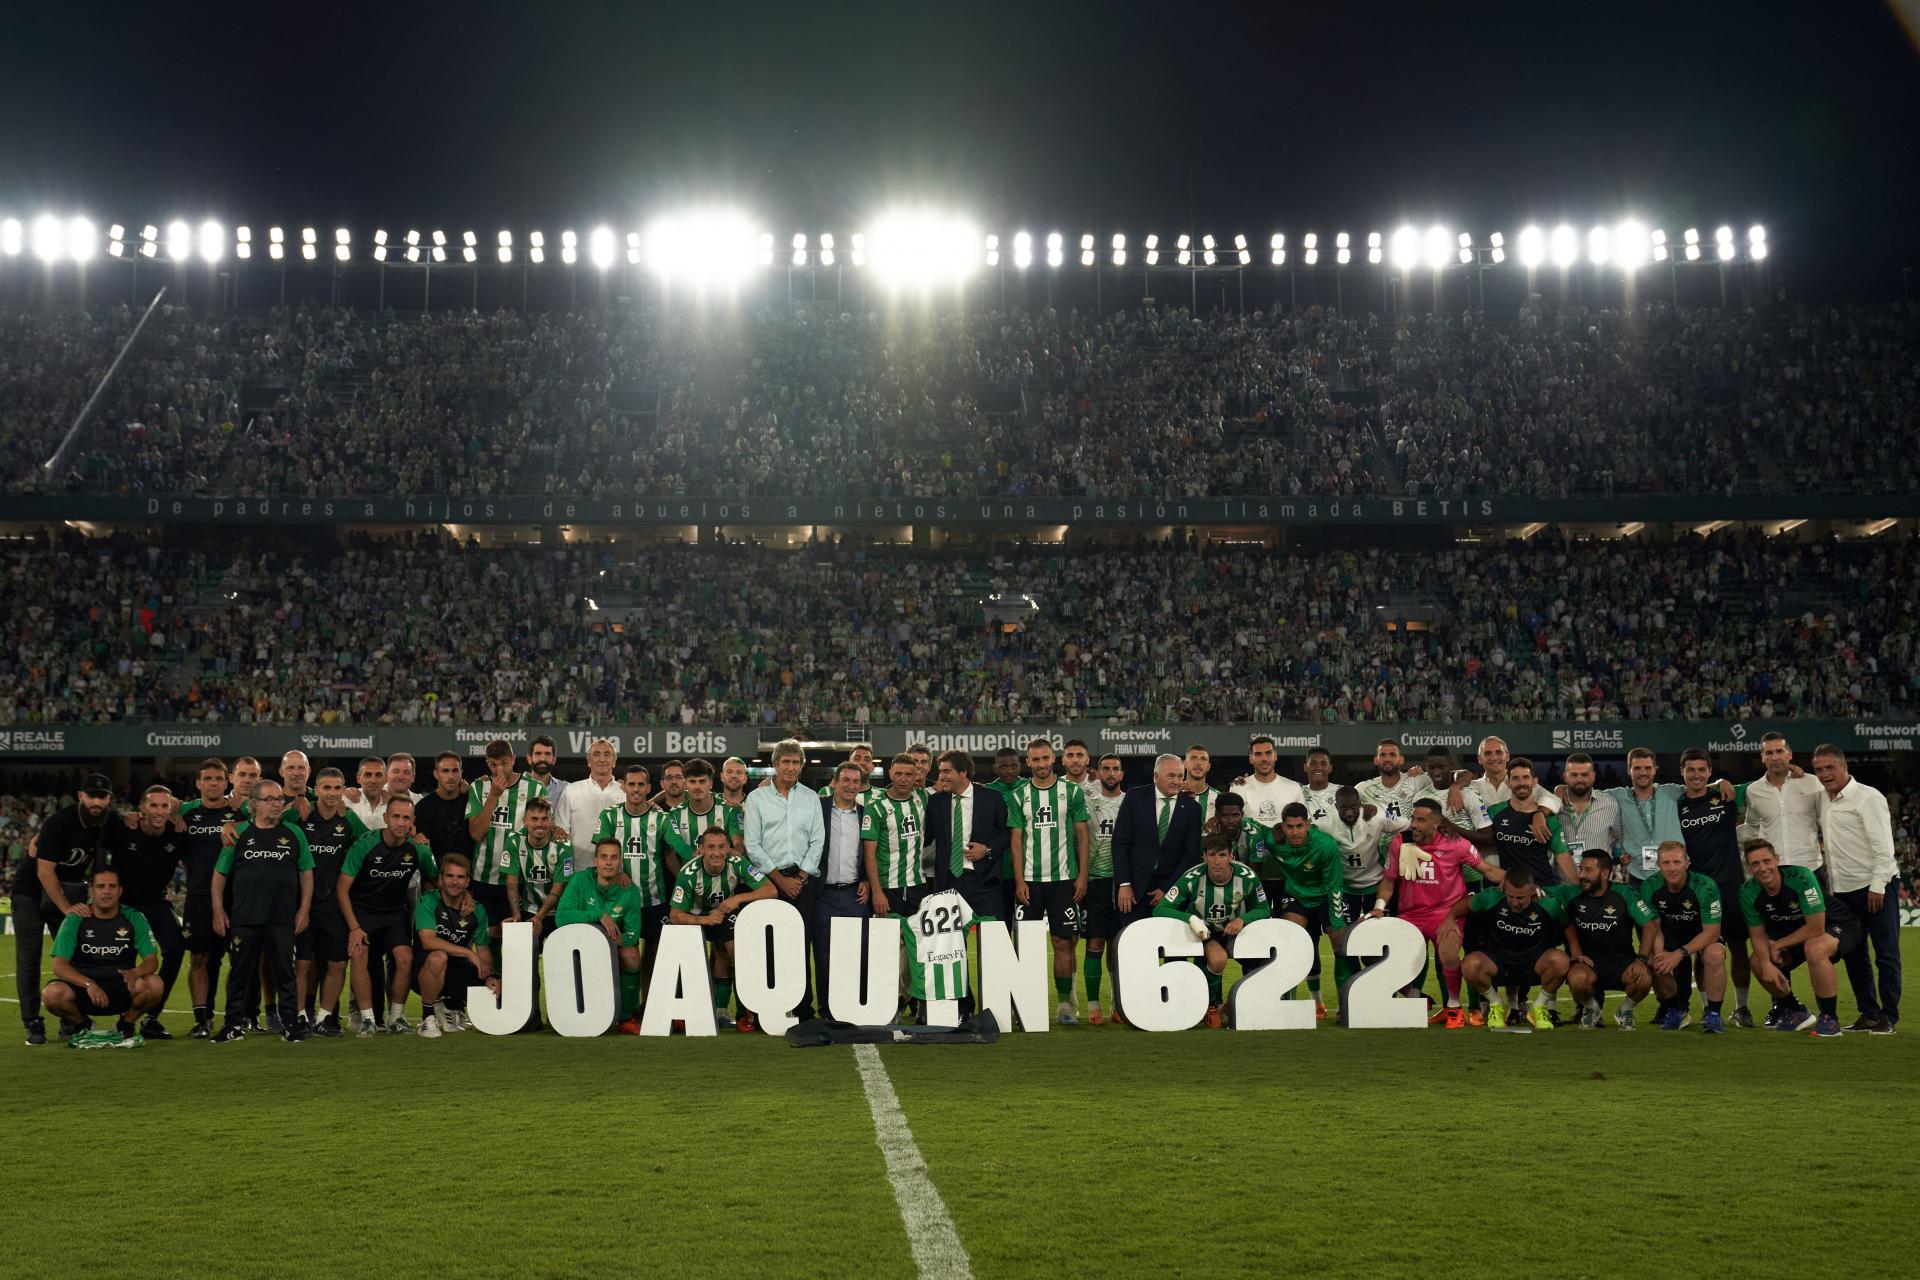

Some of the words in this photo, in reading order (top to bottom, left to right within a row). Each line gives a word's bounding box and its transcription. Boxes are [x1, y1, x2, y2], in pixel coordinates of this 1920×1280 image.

[148, 498, 182, 515] De
[214, 499, 334, 518] padres
[364, 504, 374, 516] a
[543, 501, 576, 518] de
[613, 501, 750, 518] abuelos
[788, 506, 797, 518] a
[981, 505, 1035, 518] una
[1073, 501, 1188, 520] pasión
[1224, 501, 1362, 517] llamada
[1392, 500, 1493, 516] BETIS
[13, 732, 65, 742] REALE
[147, 732, 221, 747] Cruzcampo
[455, 728, 527, 741] finetwork
[1100, 727, 1171, 740] finetwork
[1574, 730, 1623, 740] REALE
[319, 735, 374, 749] hummel
[568, 731, 620, 753] Via
[633, 731, 653, 753] el
[666, 731, 727, 753] Betis
[1401, 733, 1472, 748] Cruzcampo
[1574, 740, 1624, 749] SEGUROS
[1708, 741, 1761, 752] MuchBett
[469, 745, 487, 756] FIBR
[1114, 744, 1133, 755] FIBRA
[1138, 742, 1158, 755] MÓVIL
[188, 824, 222, 835] Corpa
[921, 904, 962, 937] 622
[466, 898, 1050, 1036] JOAQUN
[1117, 917, 1428, 1031] 622
